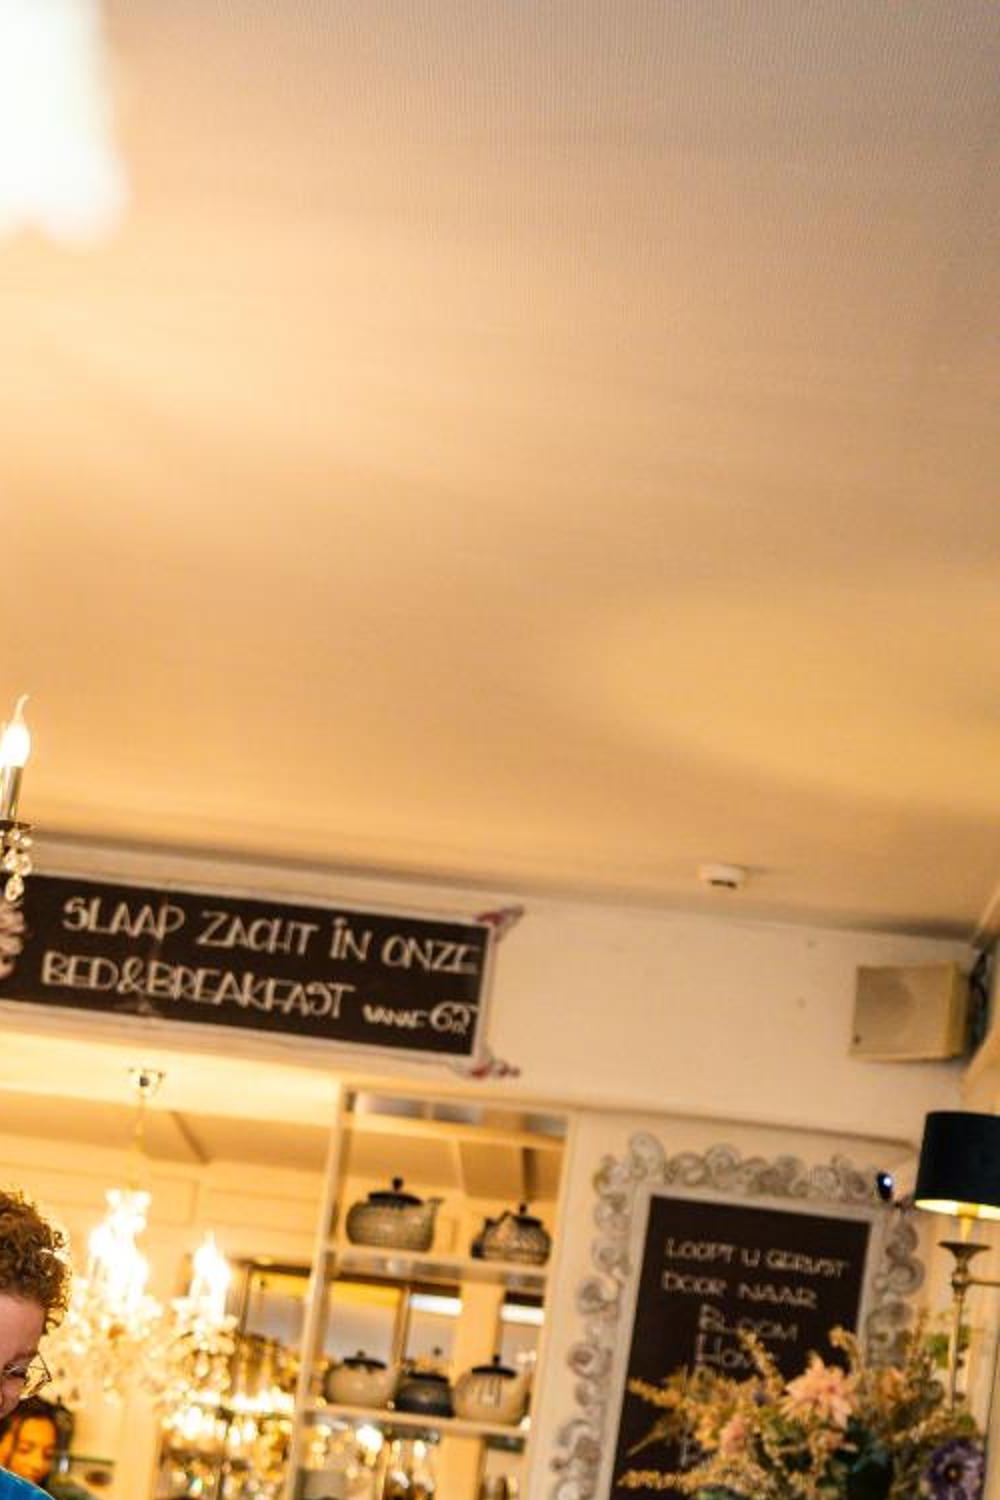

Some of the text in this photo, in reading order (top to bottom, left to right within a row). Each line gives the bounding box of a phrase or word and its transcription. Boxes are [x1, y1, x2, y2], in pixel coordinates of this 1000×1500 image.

[62, 897, 185, 941] SLAAP
[197, 908, 319, 955] ZACHT
[381, 935, 478, 975] ONZE
[42, 951, 355, 1018] BED&BREAKFAST
